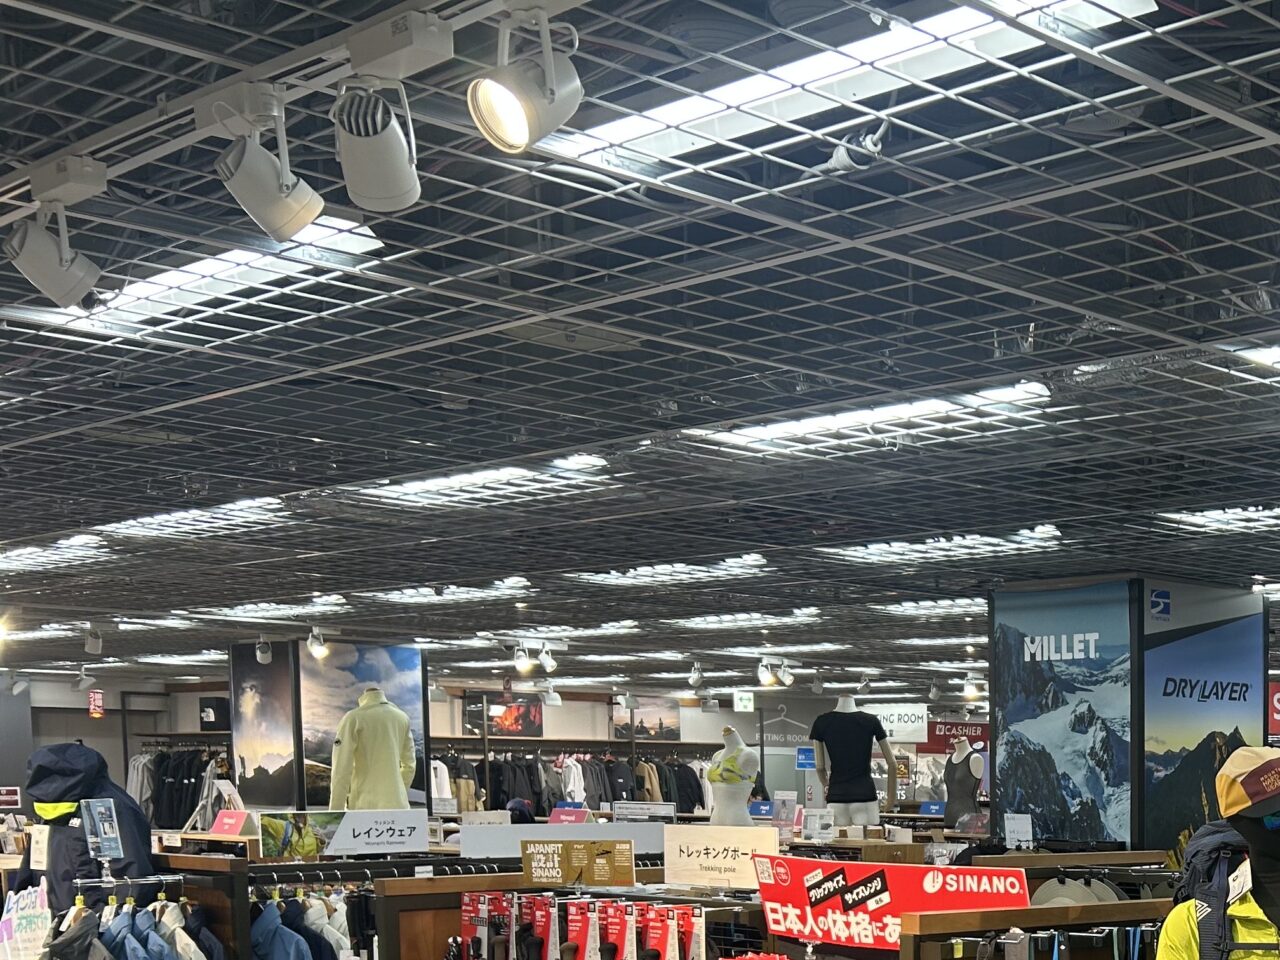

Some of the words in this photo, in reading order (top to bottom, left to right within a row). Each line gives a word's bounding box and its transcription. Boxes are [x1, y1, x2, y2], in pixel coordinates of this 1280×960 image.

[1024, 632, 1099, 662] MILLET
[898, 713, 924, 723] ROOM
[755, 732, 784, 741] FTTING
[945, 724, 982, 736] CASHIER
[352, 826, 416, 839] レインウェア
[532, 867, 562, 878] SINANO
[699, 863, 722, 874] Trekking
[809, 873, 847, 902] グリップサイズ
[844, 876, 882, 904] サイズレンジ
[945, 873, 1020, 894] SINANO
[765, 901, 901, 945] 日本人の体格にあ
